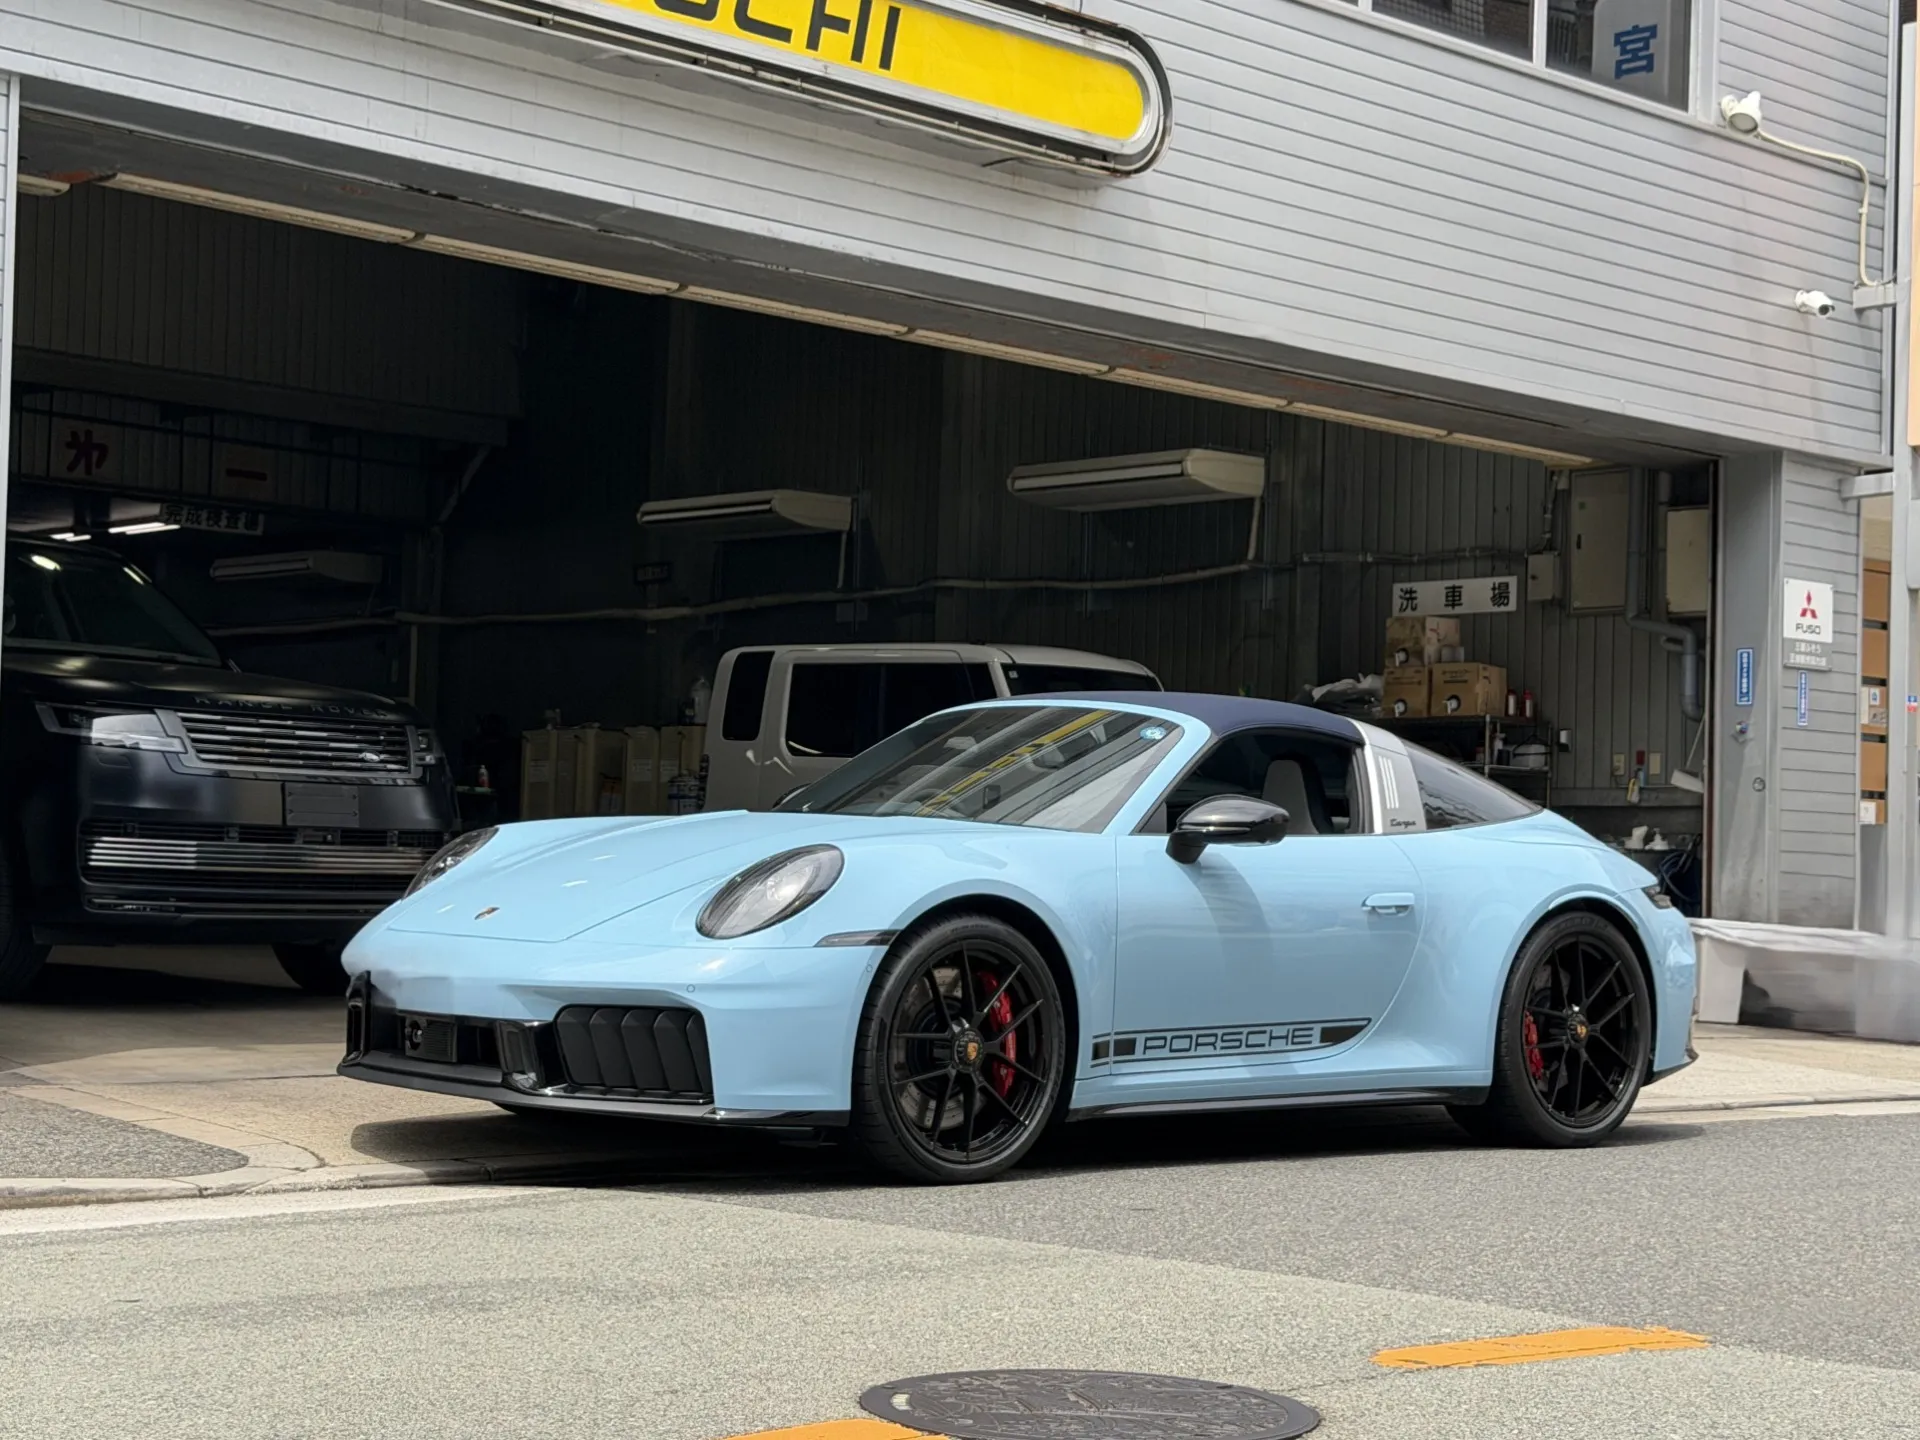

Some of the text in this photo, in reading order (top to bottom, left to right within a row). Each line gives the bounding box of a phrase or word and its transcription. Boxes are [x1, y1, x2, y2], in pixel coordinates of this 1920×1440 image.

[653, 0, 902, 72] CHI
[1613, 24, 1658, 80] 宮
[1398, 581, 1511, 613] 洗車場
[1795, 622, 1822, 635] FUSO
[1389, 817, 1417, 829] Targa
[1142, 1026, 1315, 1055] PORSCHE
